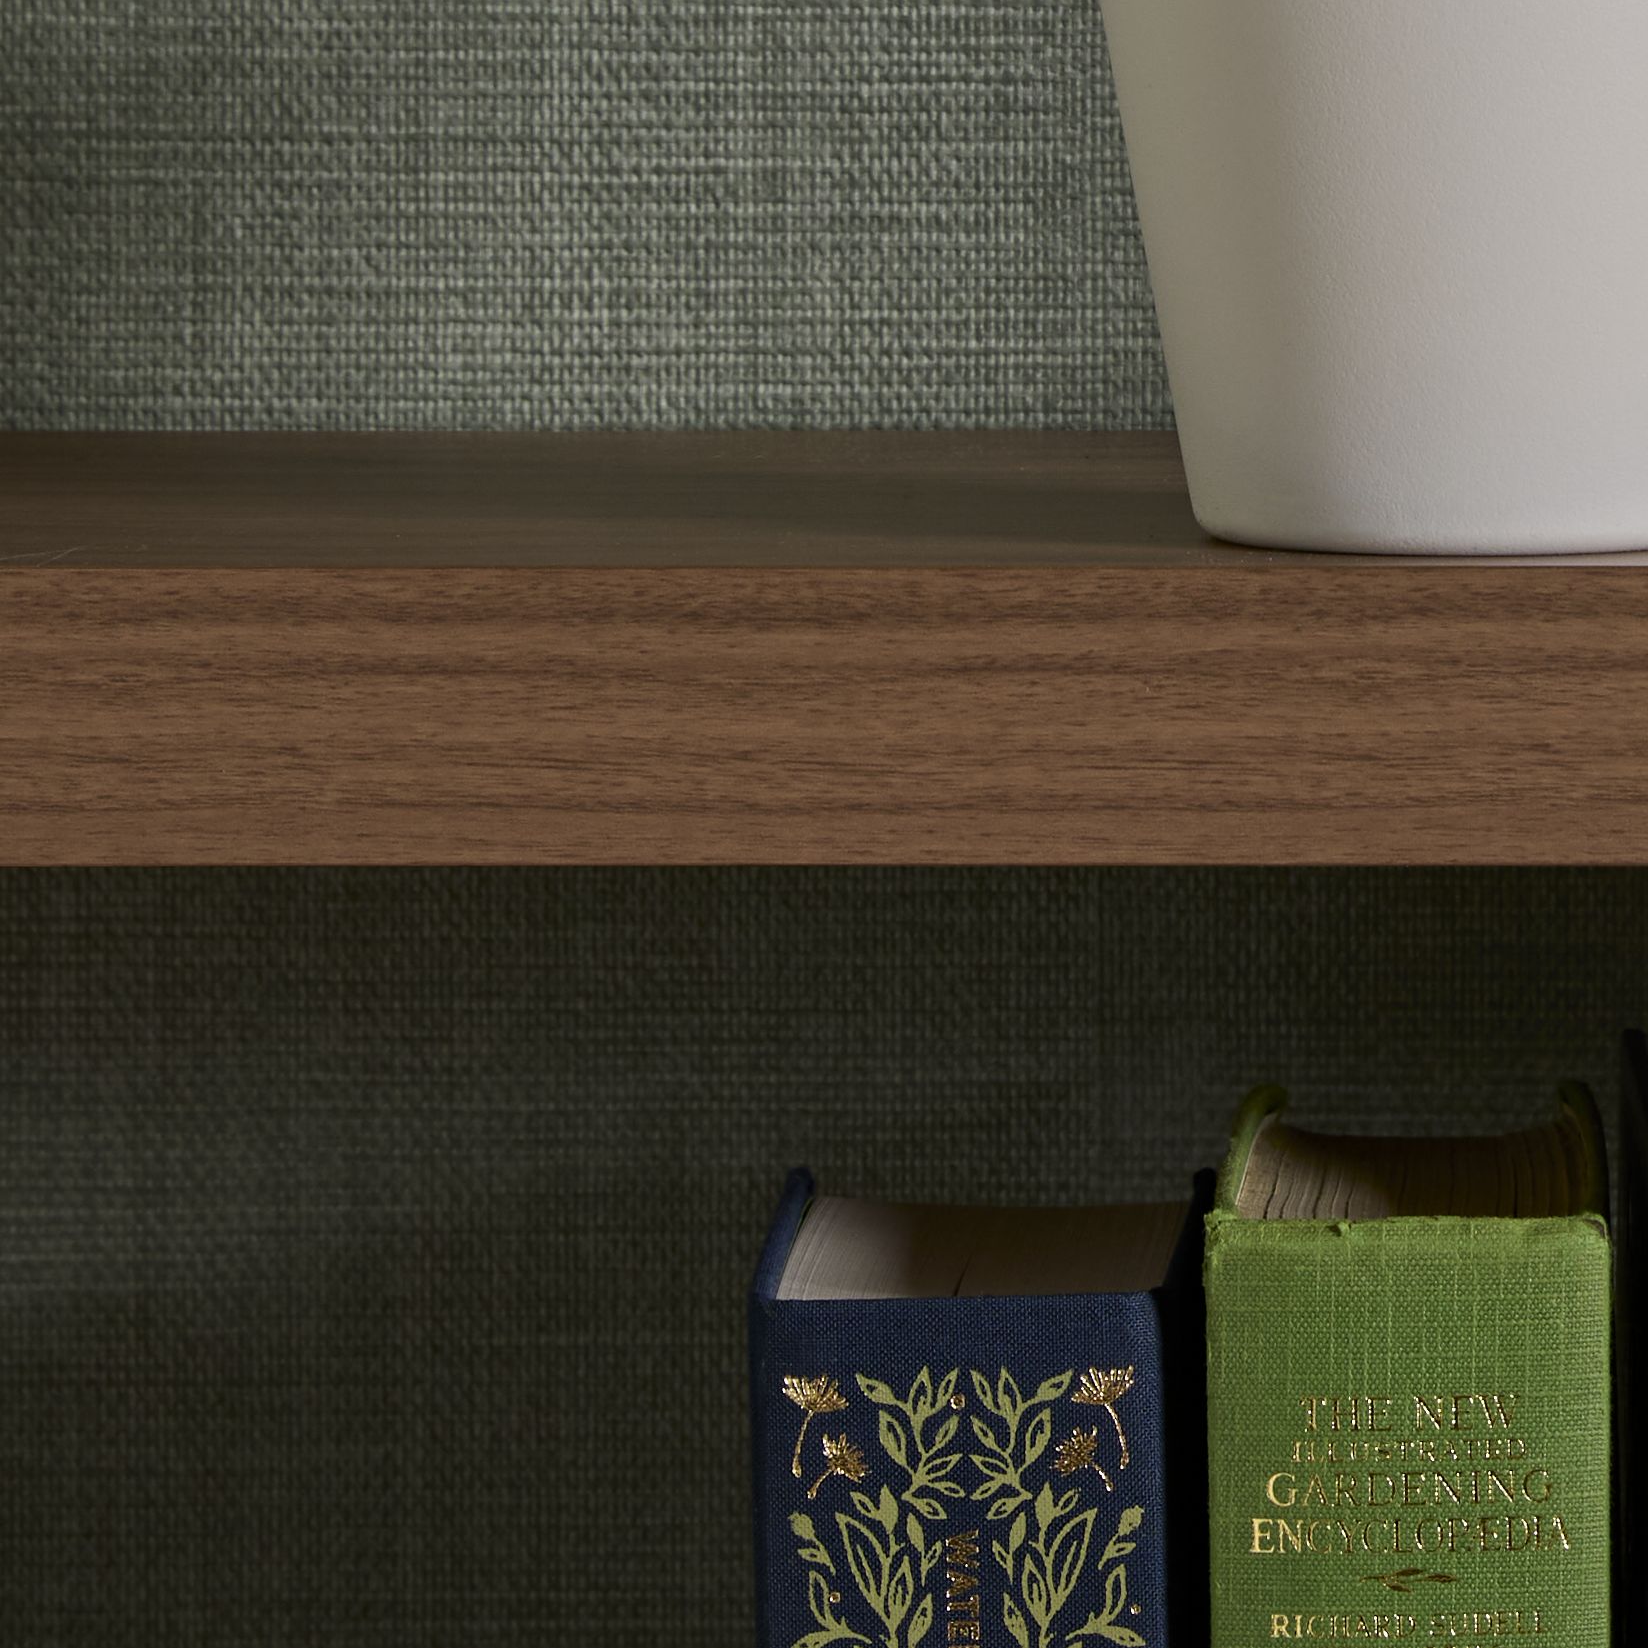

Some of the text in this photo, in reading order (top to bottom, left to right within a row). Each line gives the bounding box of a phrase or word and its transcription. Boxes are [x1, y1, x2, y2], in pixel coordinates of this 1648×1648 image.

[1300, 1393, 1521, 1433] THE NEW
[1291, 1439, 1528, 1463] ILLUSTRATED
[1265, 1469, 1553, 1507] GARDENING
[945, 1529, 981, 1648] WATE
[1270, 1608, 1547, 1639] RICHARD SUDELL
